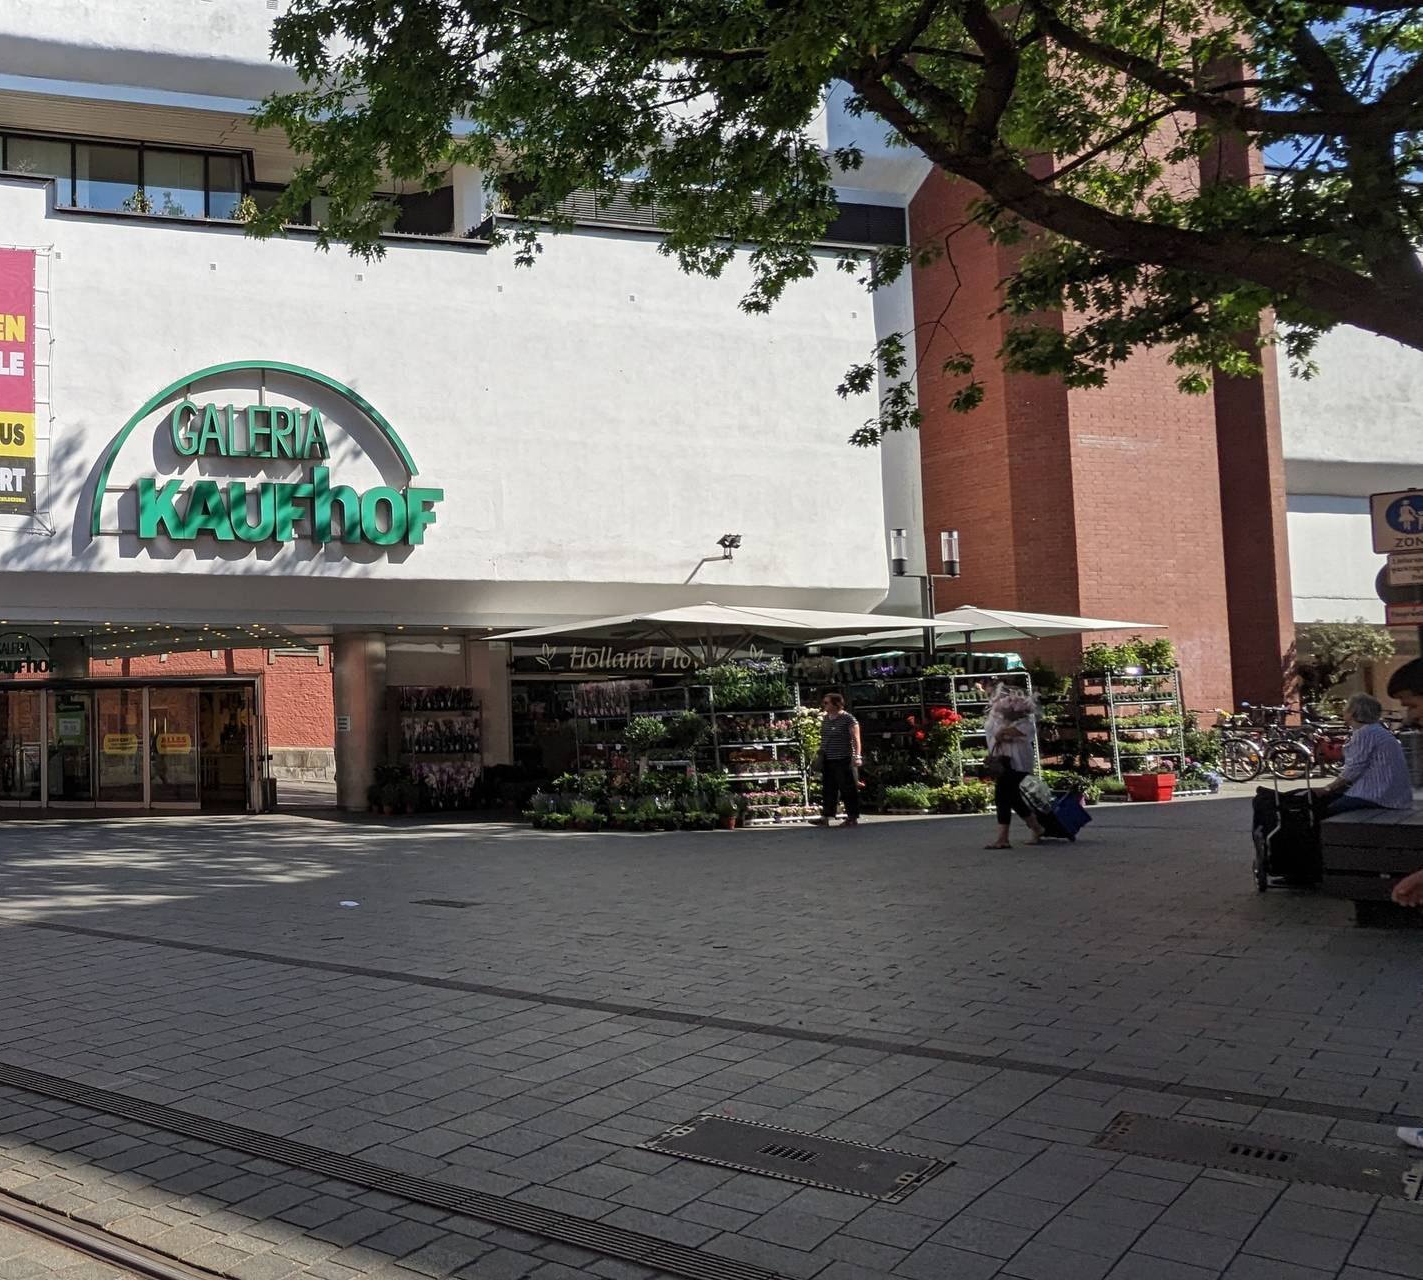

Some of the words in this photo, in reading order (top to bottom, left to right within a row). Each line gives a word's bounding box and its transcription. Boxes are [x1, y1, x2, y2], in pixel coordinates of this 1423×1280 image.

[169, 400, 330, 459] GALERIA
[570, 646, 655, 670] Holland
[662, 646, 705, 670] Flo
